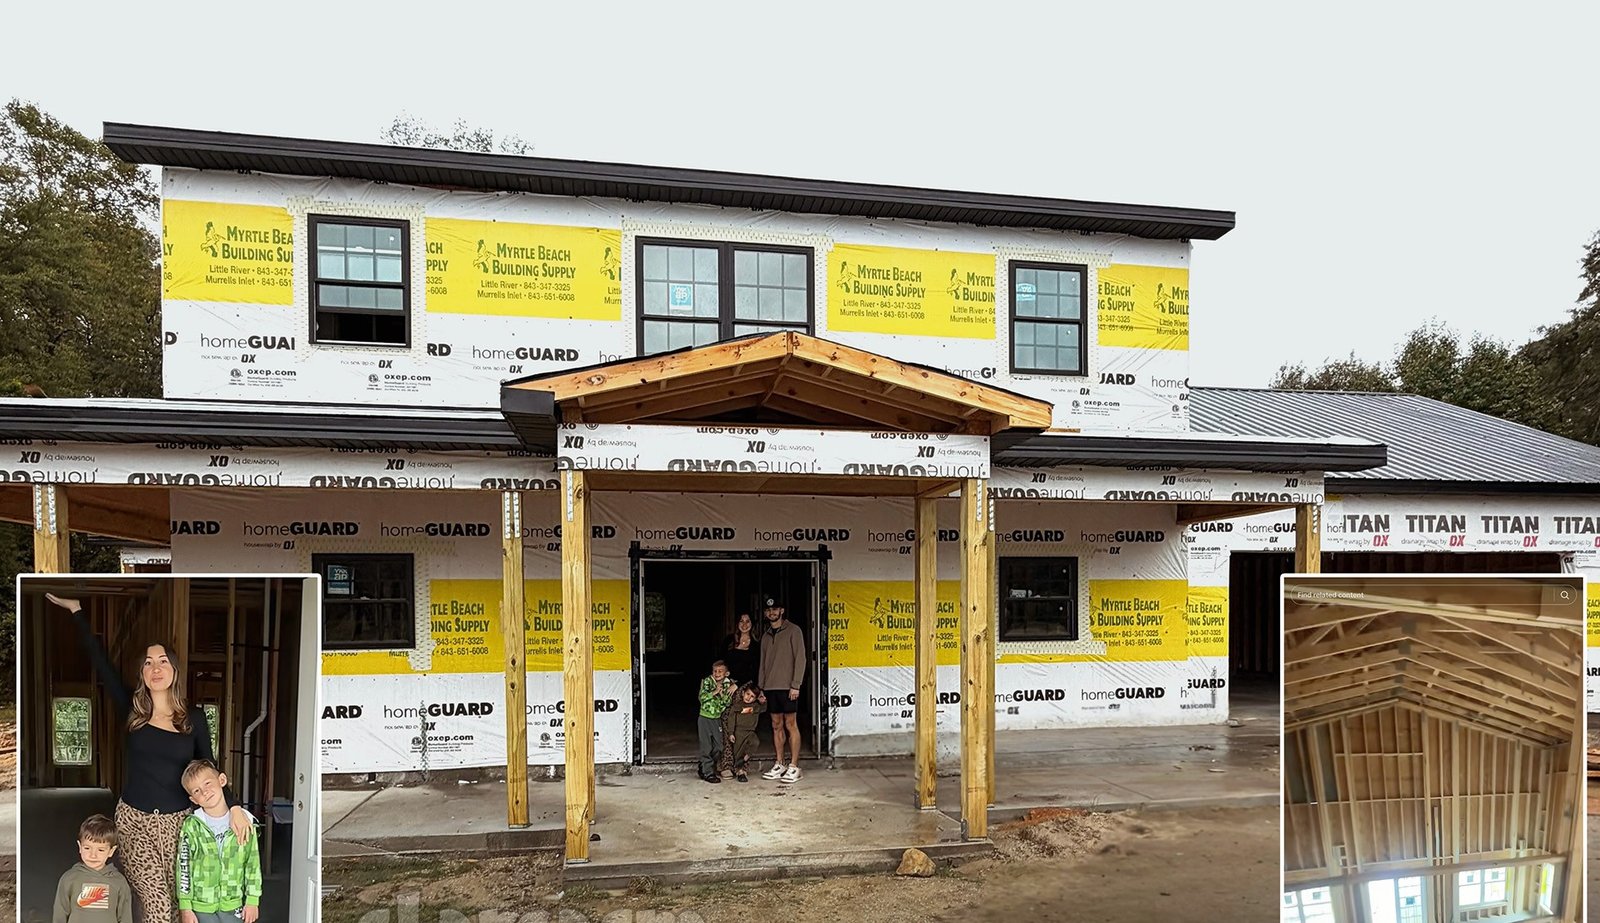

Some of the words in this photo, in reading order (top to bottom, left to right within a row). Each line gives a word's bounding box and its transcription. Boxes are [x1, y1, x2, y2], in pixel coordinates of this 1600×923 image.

[226, 225, 270, 244] MYRTLE
[221, 244, 274, 263] BUILDING
[496, 242, 535, 260] MYRTLE
[538, 245, 571, 262] BEACH
[209, 264, 229, 274] Little
[231, 265, 250, 275] River
[492, 259, 539, 277] BUILDING
[541, 262, 576, 279] SUPPLY
[857, 265, 891, 281] MYRTLE
[892, 267, 922, 282] BEACH
[205, 275, 237, 285] Murrells
[238, 276, 256, 286] Inlet
[481, 280, 500, 288] Little
[501, 281, 518, 289] River
[523, 282, 571, 291] 843-347-3325
[853, 280, 894, 297] BUILDING
[896, 283, 926, 299] SUPPLY
[1104, 281, 1131, 297] BEACH
[477, 290, 506, 299] Murrells
[507, 291, 523, 299] Inlet
[528, 292, 575, 301] 843-651-6008
[843, 299, 858, 307] Little
[860, 300, 875, 308] River
[880, 301, 921, 310] 843-347-3325
[969, 306, 984, 314] River
[1107, 298, 1135, 312] SUPPLY
[840, 308, 865, 317] Murrells
[866, 309, 880, 318] Inlet
[883, 310, 925, 320] 843-651-6008
[950, 315, 974, 323] Murrells
[974, 316, 987, 324] Inlet
[1159, 318, 1173, 326] Little
[200, 333, 295, 350] homeGUA
[241, 353, 256, 364] OX
[472, 345, 579, 362] homeGUARD
[378, 359, 393, 369] OX
[509, 364, 523, 374] OX
[246, 368, 297, 377] oxep.com
[384, 373, 431, 382] oxep.com
[1080, 387, 1091, 396] OX
[1084, 399, 1120, 407] oxep.com
[564, 435, 584, 449] OX
[747, 441, 766, 453] OX
[917, 445, 935, 458] OX
[20, 451, 41, 464] OX
[207, 455, 229, 467] OX
[386, 459, 405, 470] OX
[1031, 472, 1047, 483] OX
[1160, 475, 1176, 486] OX
[1285, 478, 1299, 488] OX
[243, 521, 359, 536] homeGUARD
[1405, 515, 1466, 533] TITAN
[1480, 515, 1539, 534] TITAN
[1553, 516, 1600, 534] TITA
[635, 526, 735, 540] homeGUARD
[754, 528, 850, 542] homeGUARD
[1081, 530, 1165, 543] homeGUARD
[1372, 534, 1389, 547] OX
[1449, 534, 1465, 547] OX
[1522, 535, 1538, 547] OX
[899, 546, 912, 554] OX
[1109, 546, 1121, 555] OX
[450, 600, 484, 615] BEACH
[1101, 598, 1131, 611] MYRTLE
[1133, 598, 1160, 611] BEACH
[1200, 602, 1222, 613] BEACH
[454, 617, 490, 632] SUPPLY
[1097, 613, 1134, 626] BUILDING
[1136, 613, 1163, 626] SUPPLY
[1202, 615, 1225, 626] SUPPLY
[541, 636, 558, 644] River
[877, 634, 892, 642] Little
[893, 633, 909, 642] River
[1103, 631, 1117, 639] River
[1122, 630, 1159, 638] 843-347-3325
[436, 637, 484, 646] 843-347-3325
[874, 643, 898, 651] Murrells
[899, 642, 913, 650] Inlet
[1125, 639, 1162, 647] 843-651-6008
[440, 646, 488, 655] 843-651-6008
[1081, 687, 1165, 701] homeGUARD
[384, 702, 494, 718] homeGUARD
[901, 709, 913, 718] OX
[549, 718, 563, 727] OX
[428, 734, 474, 742] oxep.com
